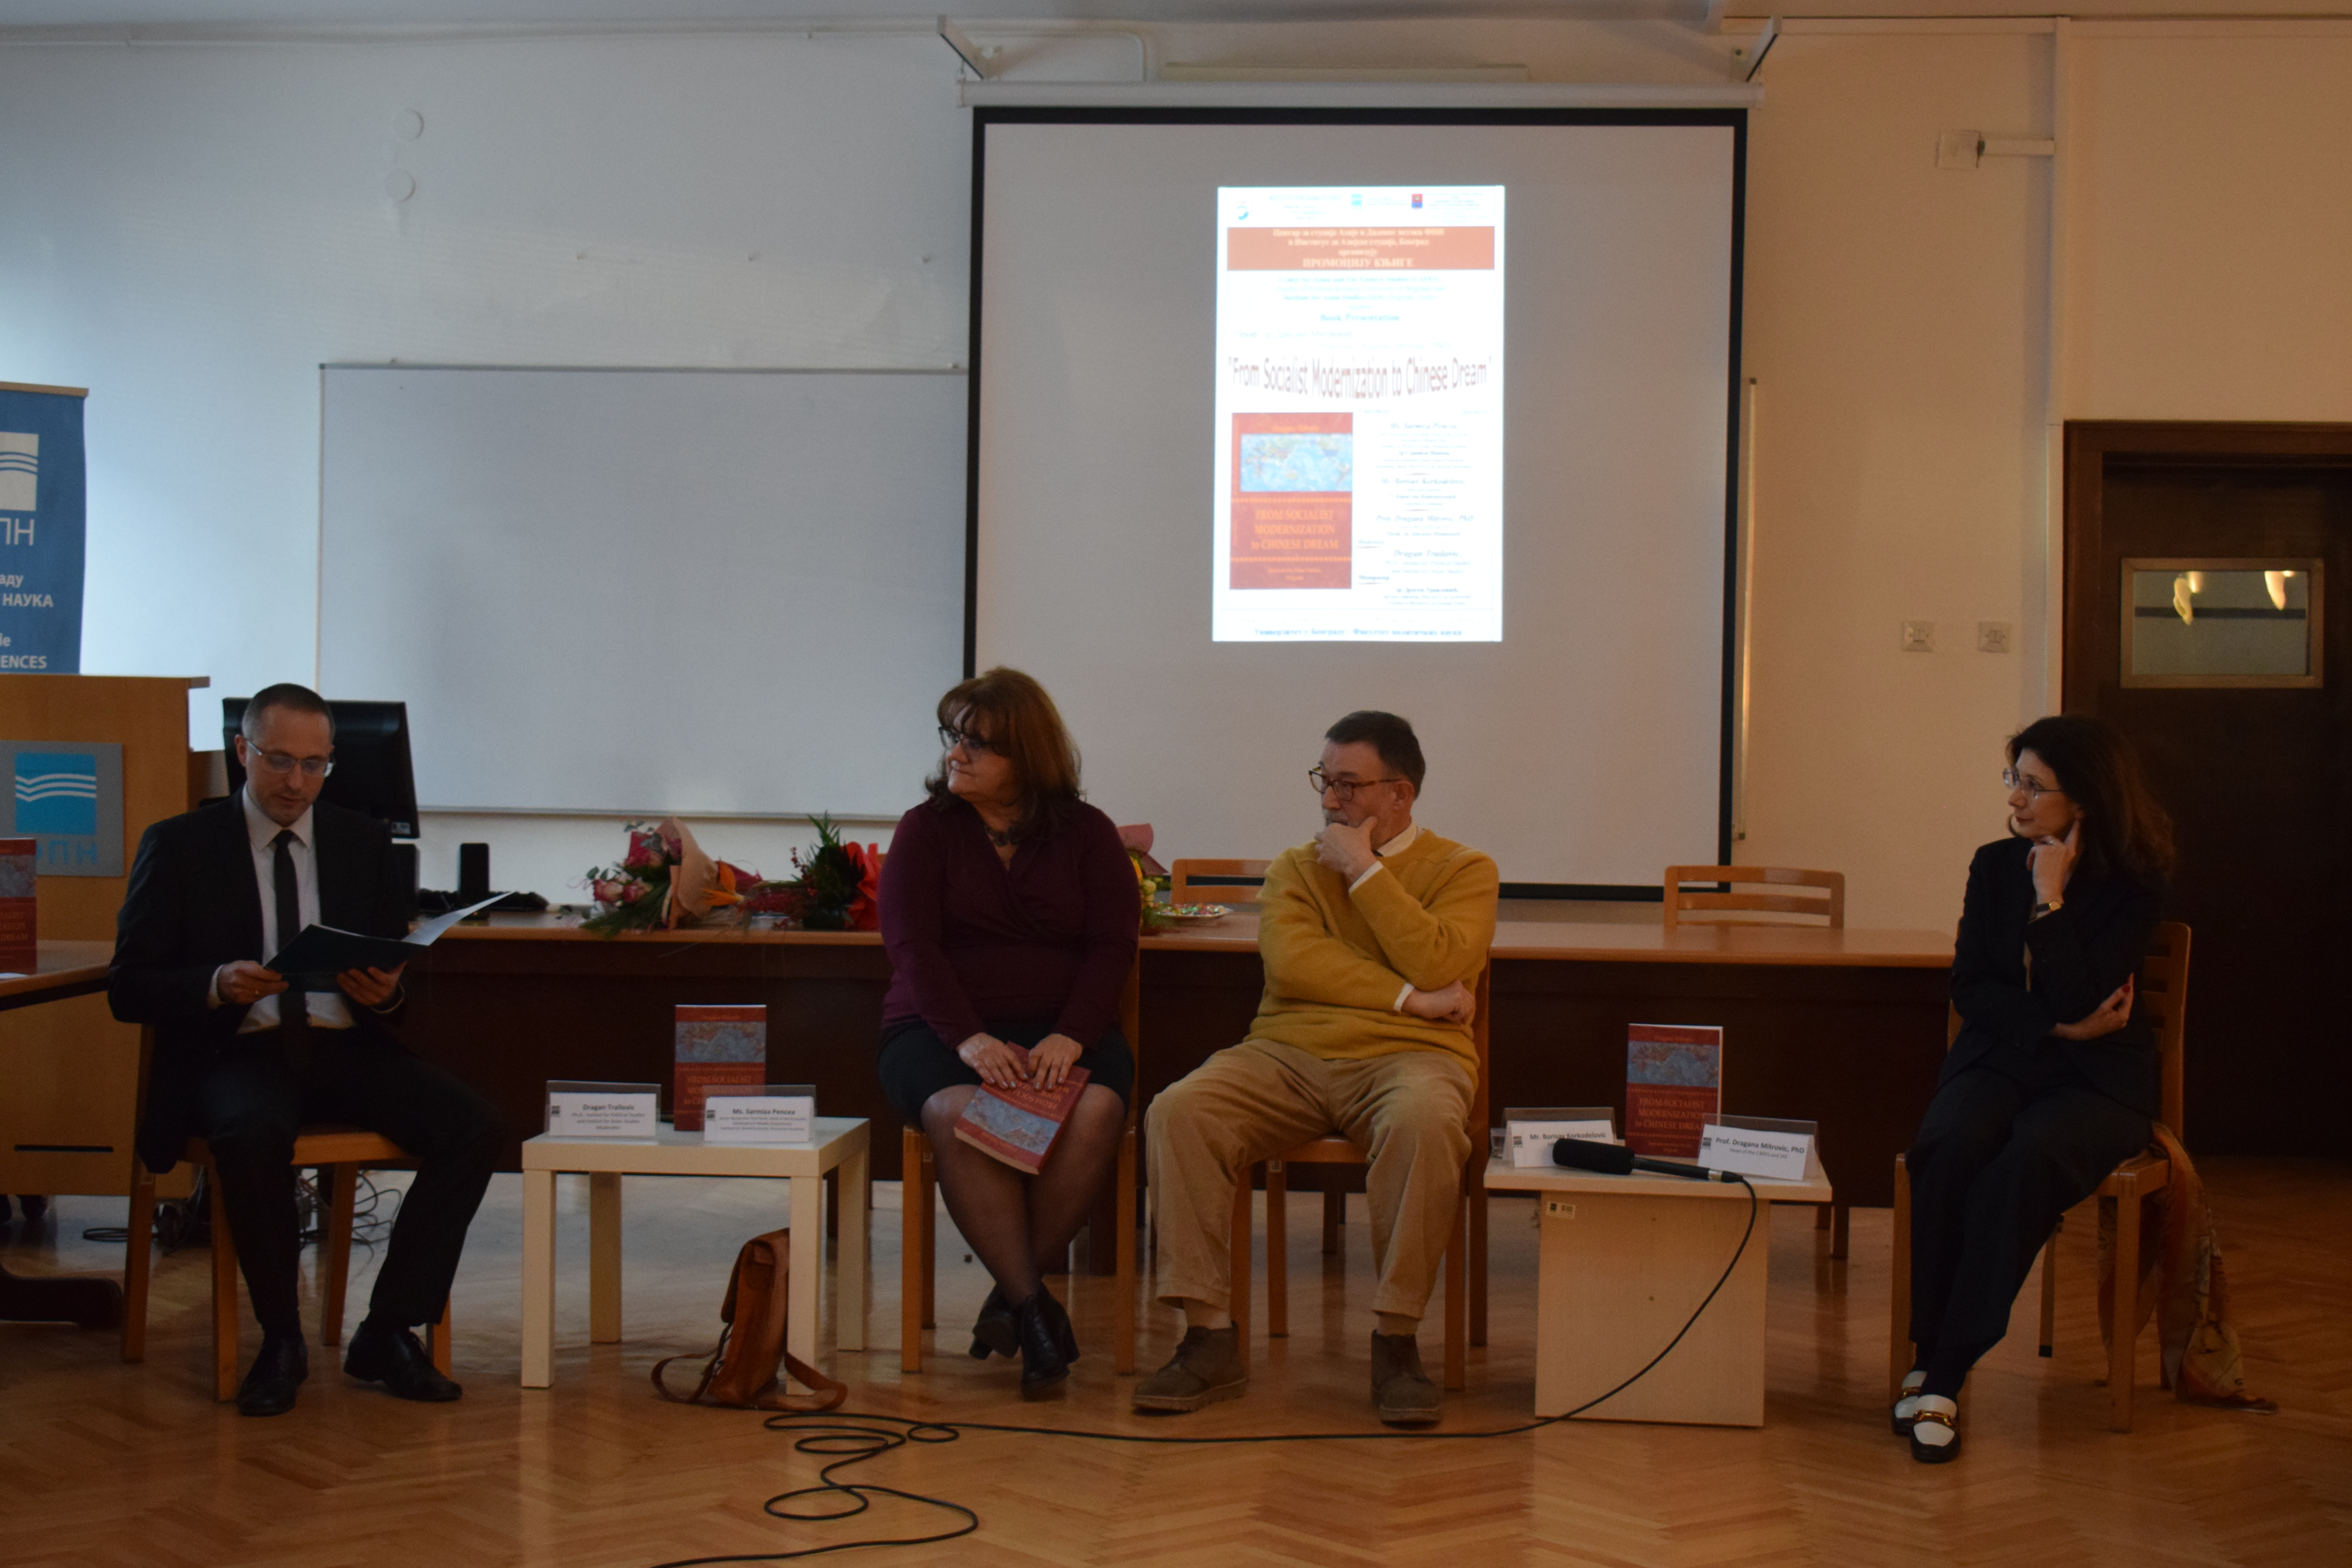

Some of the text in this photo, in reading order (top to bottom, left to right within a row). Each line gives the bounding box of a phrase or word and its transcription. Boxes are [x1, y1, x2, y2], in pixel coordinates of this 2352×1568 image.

[1263, 356, 1308, 396] Socialist
[1312, 356, 1388, 399] Modernization
[1391, 358, 1402, 397] to
[1406, 356, 1448, 396] Chinese
[1256, 510, 1334, 520] FROM SOCIALIST
[1254, 524, 1336, 535] MODERNIZATION
[1261, 539, 1301, 550] CHINESE
[1303, 539, 1339, 550] DREAM
[2, 593, 54, 607] НАУКА
[1639, 1098, 1704, 1109] FROM SOCIALIST
[1638, 1108, 1705, 1119] MODERNIZATION
[1643, 1120, 1678, 1129] CHINESE
[1732, 1139, 1759, 1149] Dragana
[1760, 1142, 1789, 1152] Mitrovic,
